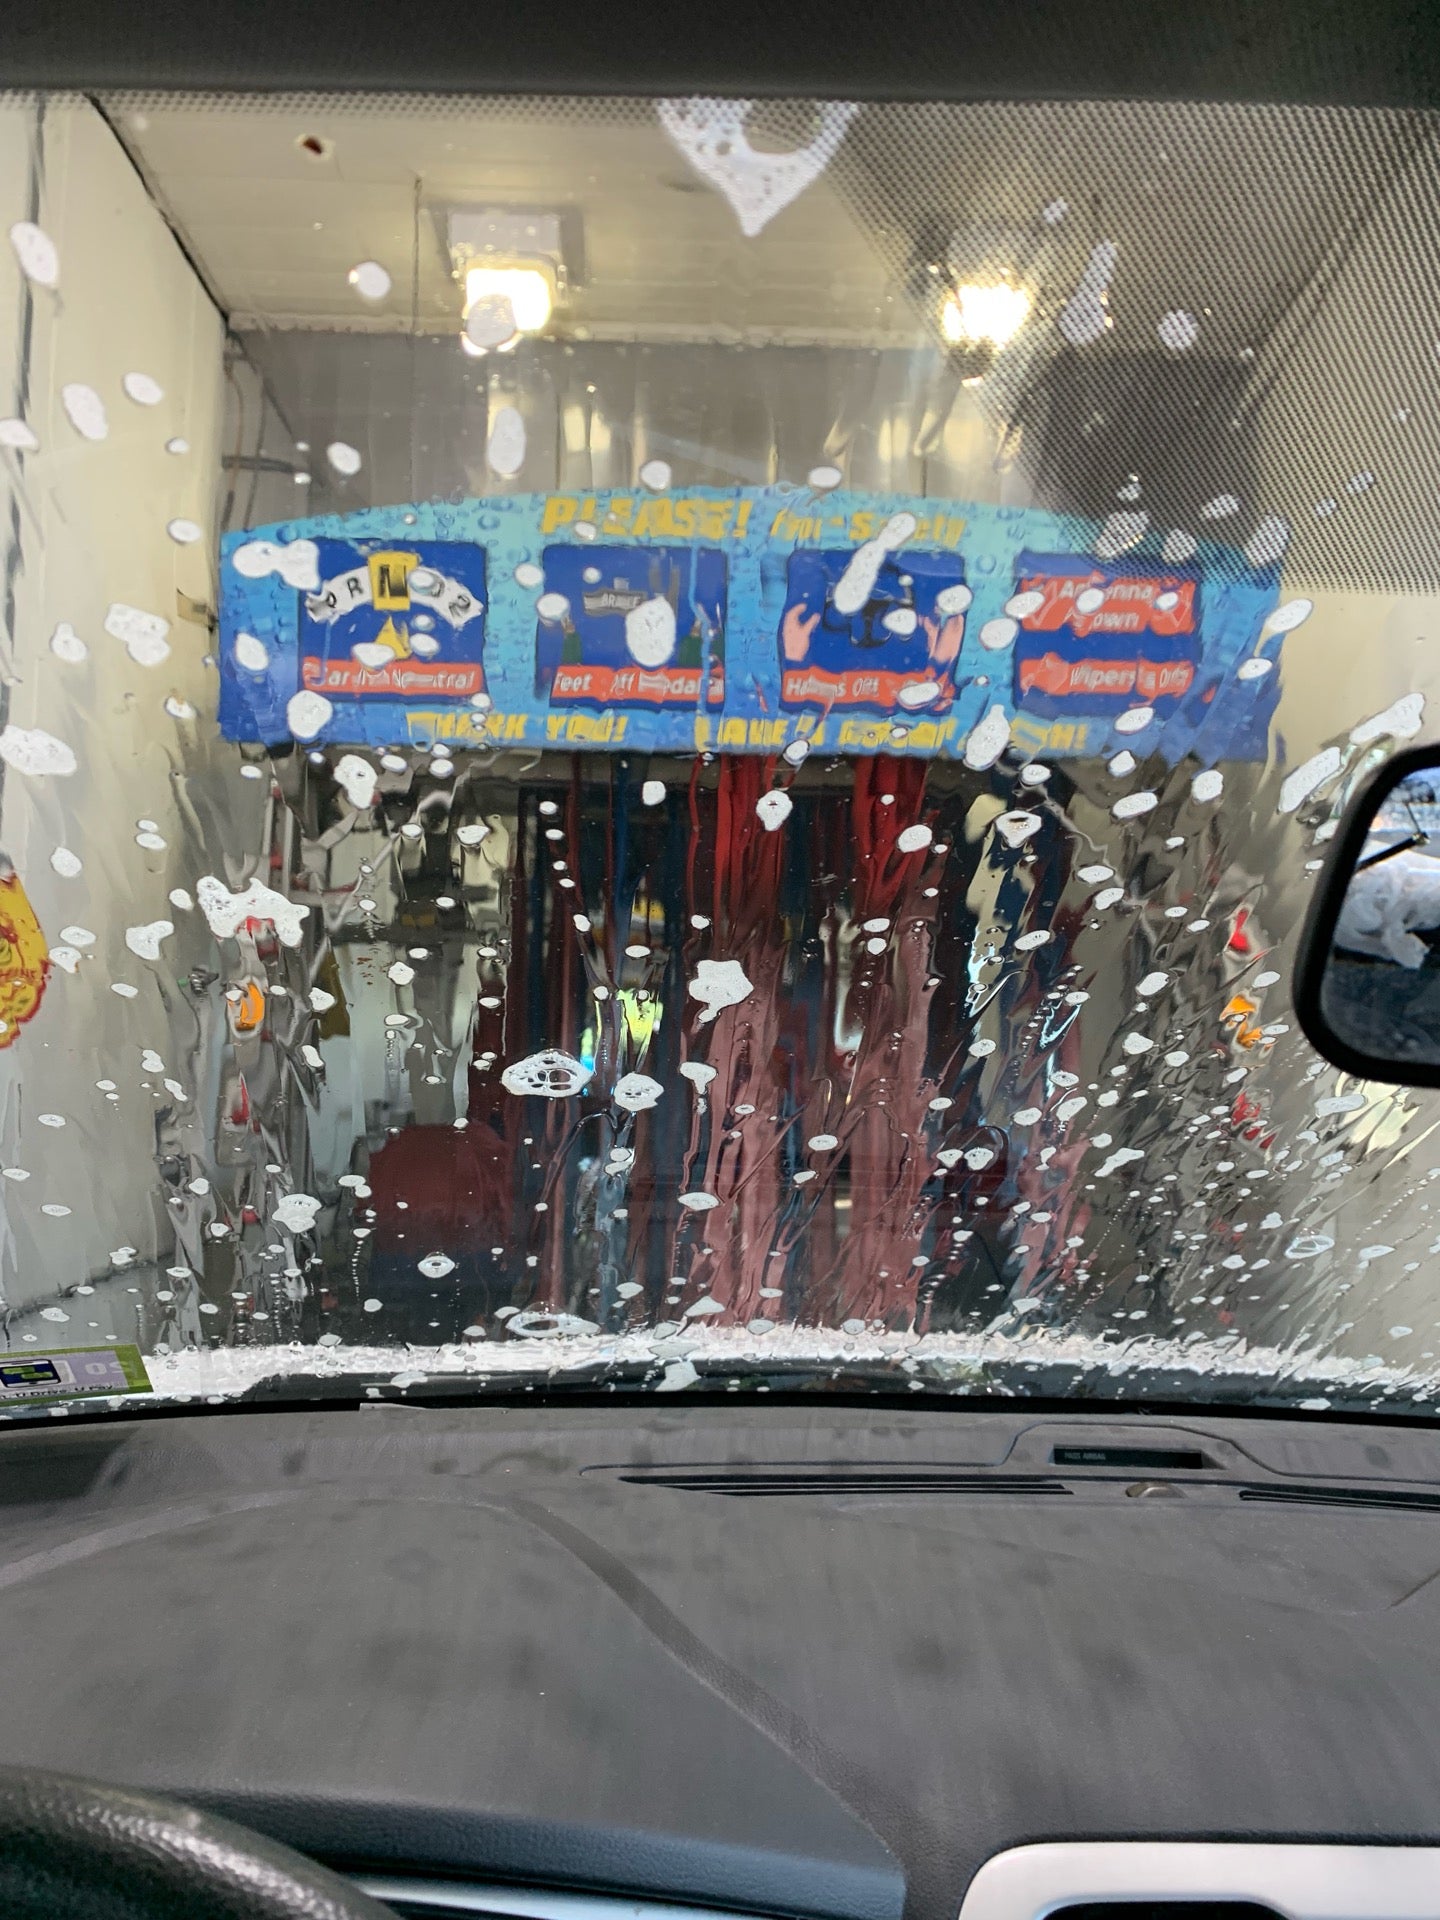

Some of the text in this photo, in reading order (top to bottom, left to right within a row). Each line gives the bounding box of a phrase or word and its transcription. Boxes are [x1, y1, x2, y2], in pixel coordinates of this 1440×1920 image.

[541, 497, 753, 540] PLEASE!
[849, 511, 966, 549] Sety
[378, 564, 408, 598] N
[1058, 579, 1154, 602] Annna
[303, 662, 350, 687] ar
[392, 669, 475, 690] Netral
[638, 671, 724, 697] edal
[784, 675, 847, 697] Has
